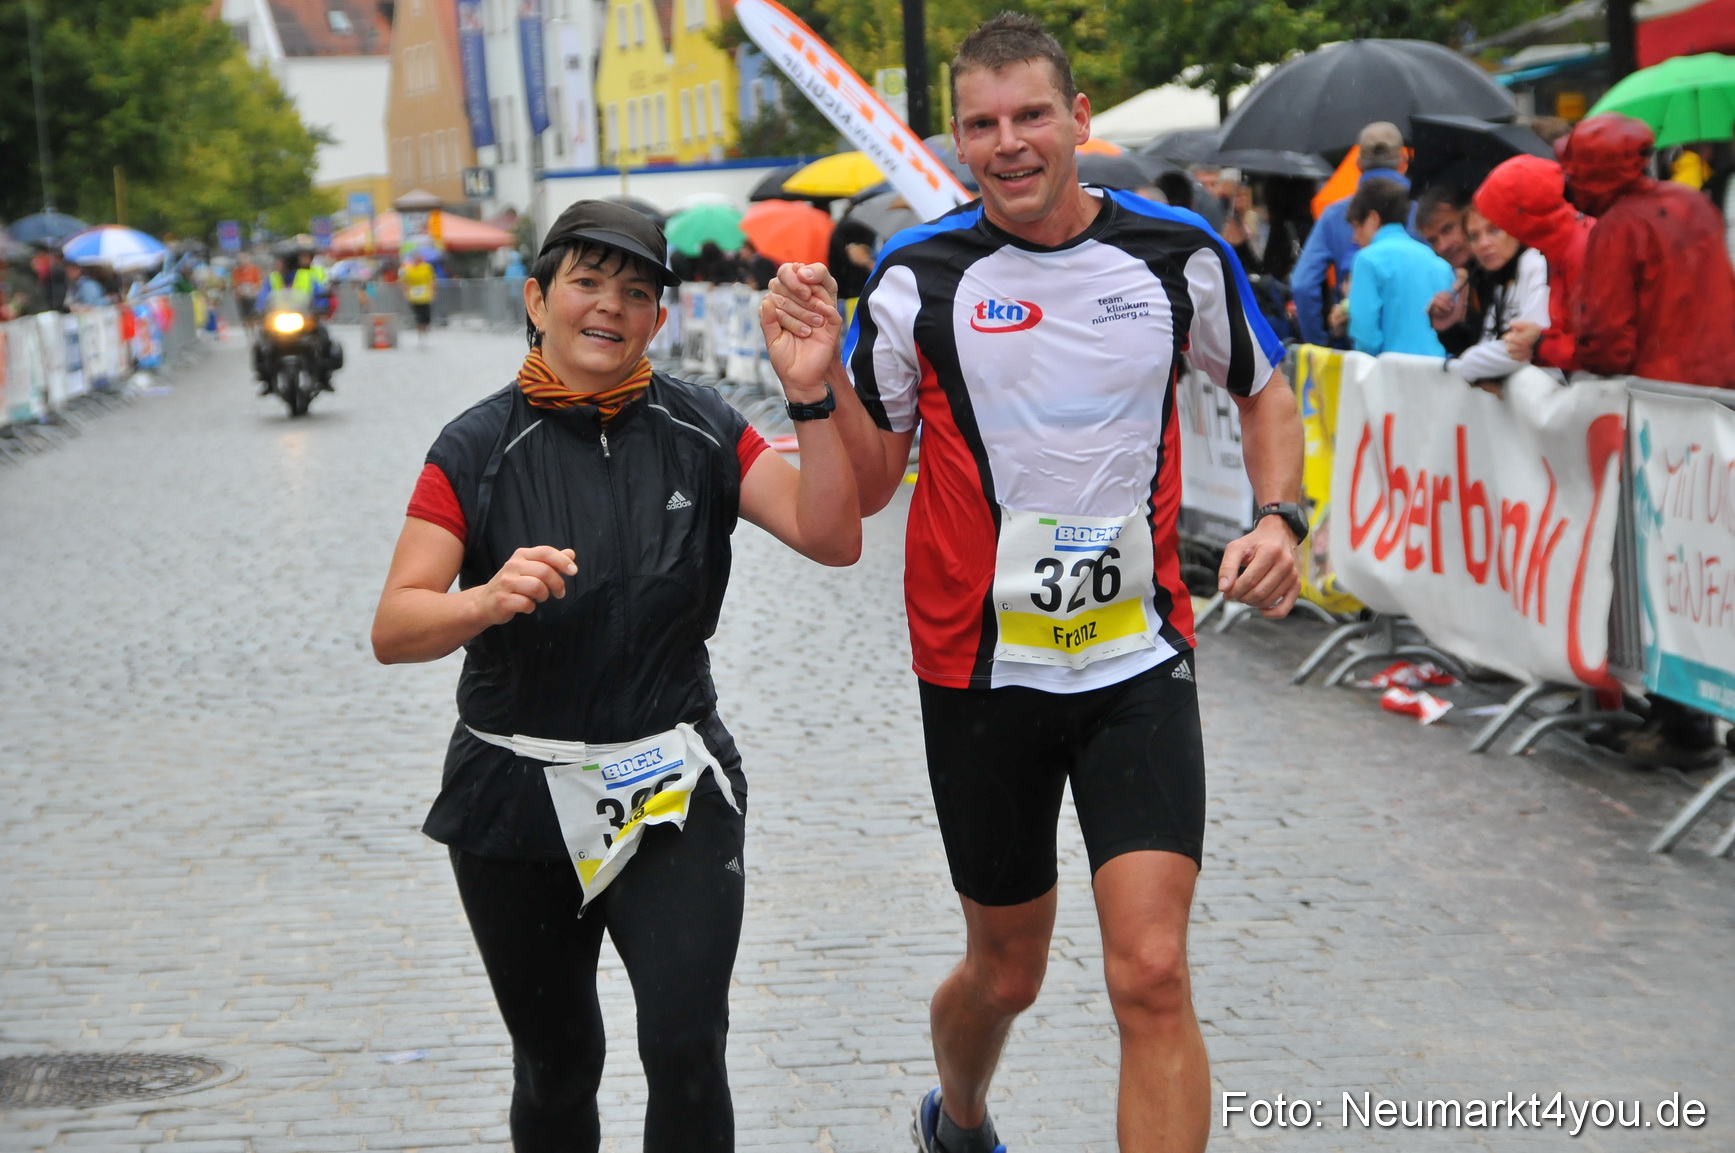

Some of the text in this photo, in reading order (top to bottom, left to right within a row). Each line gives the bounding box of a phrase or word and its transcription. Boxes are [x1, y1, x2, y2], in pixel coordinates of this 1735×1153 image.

[974, 299, 1023, 321] tkn
[1098, 296, 1123, 306] team
[1106, 301, 1149, 313] klinikum
[1092, 311, 1138, 325] nürnberg
[1055, 526, 1122, 542] BOCK
[1030, 547, 1121, 613] 326
[1053, 621, 1097, 648] Franz
[601, 747, 663, 780] BOCK
